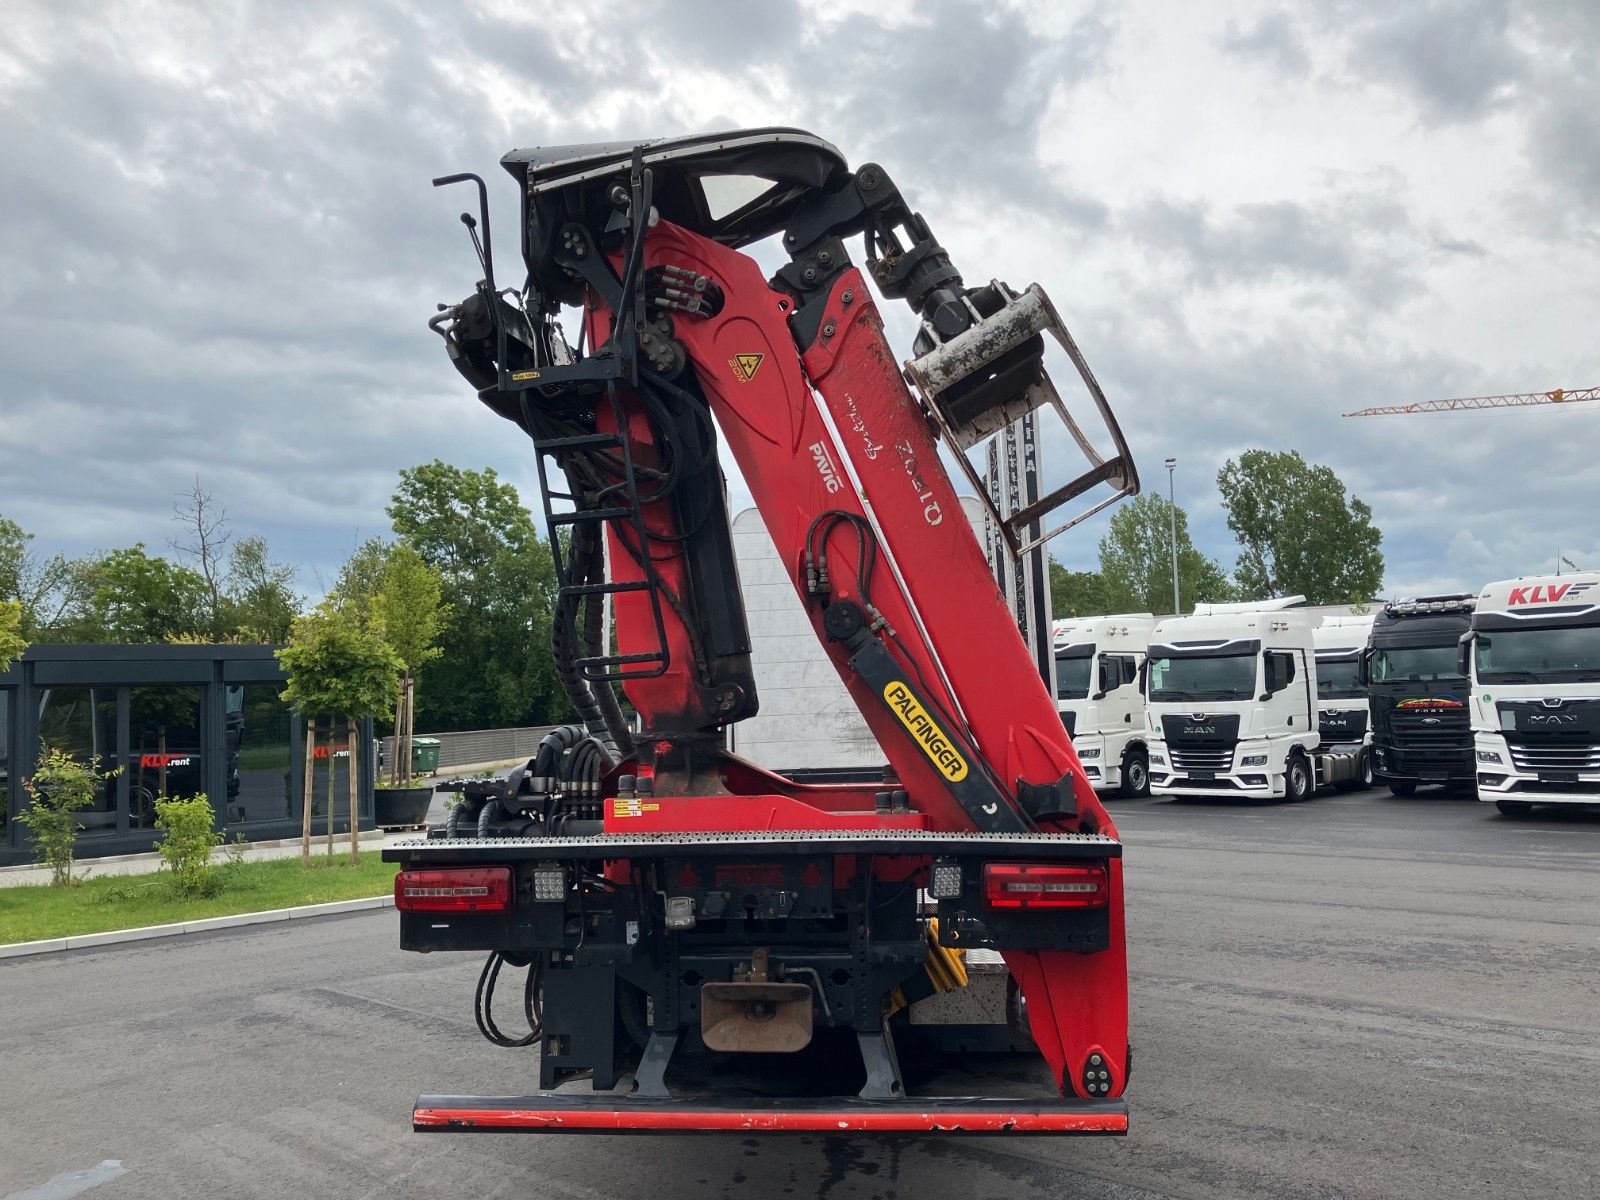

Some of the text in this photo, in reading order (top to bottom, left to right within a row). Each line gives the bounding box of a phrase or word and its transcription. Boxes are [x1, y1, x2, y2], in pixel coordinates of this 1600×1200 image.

[1508, 583, 1572, 606] KLV
[888, 686, 963, 777] PALFINGER
[1184, 726, 1216, 734] MAN
